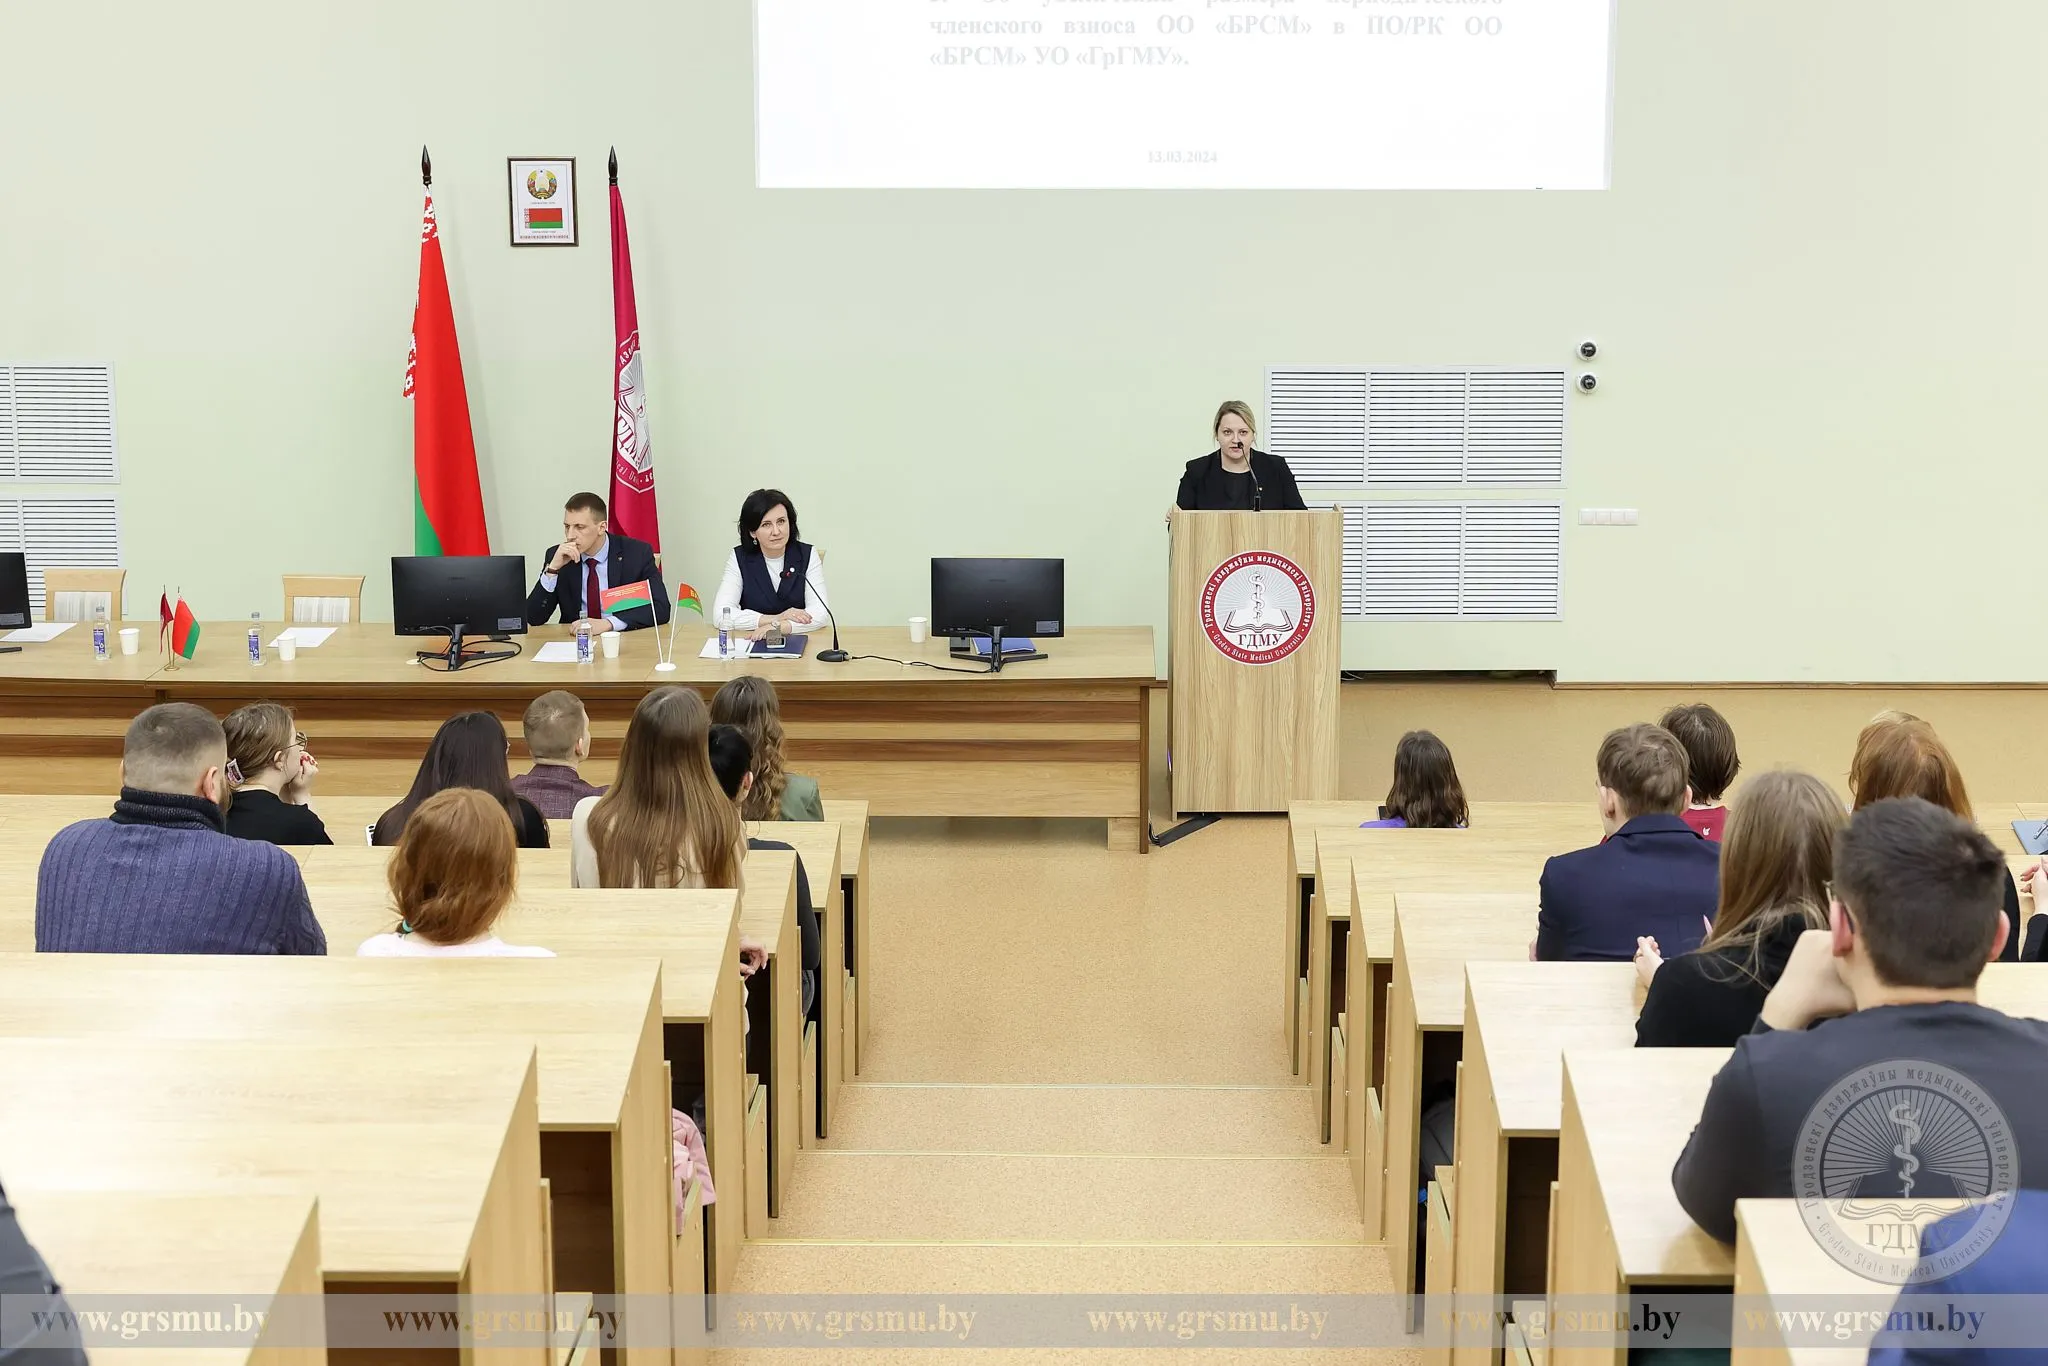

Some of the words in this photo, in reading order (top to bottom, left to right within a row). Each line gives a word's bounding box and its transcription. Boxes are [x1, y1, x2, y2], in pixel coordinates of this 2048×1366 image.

[929, 20, 1043, 35] членского
[1063, 20, 1136, 35] взноса
[1156, 14, 1194, 35] ОО
[1214, 14, 1312, 36] «БРСМ»
[1333, 21, 1345, 35] в
[1367, 15, 1445, 36] ПО/РК
[1464, 16, 1503, 36] ОО
[929, 46, 1027, 66] «БРСМ»
[1034, 46, 1070, 66] УО
[1075, 46, 1189, 71] «ГрГМУ».
[1148, 150, 1218, 164] 13.03.2024
[1238, 633, 1283, 649] ГДМУ
[1231, 648, 1248, 660] State
[1249, 652, 1274, 661] Medical
